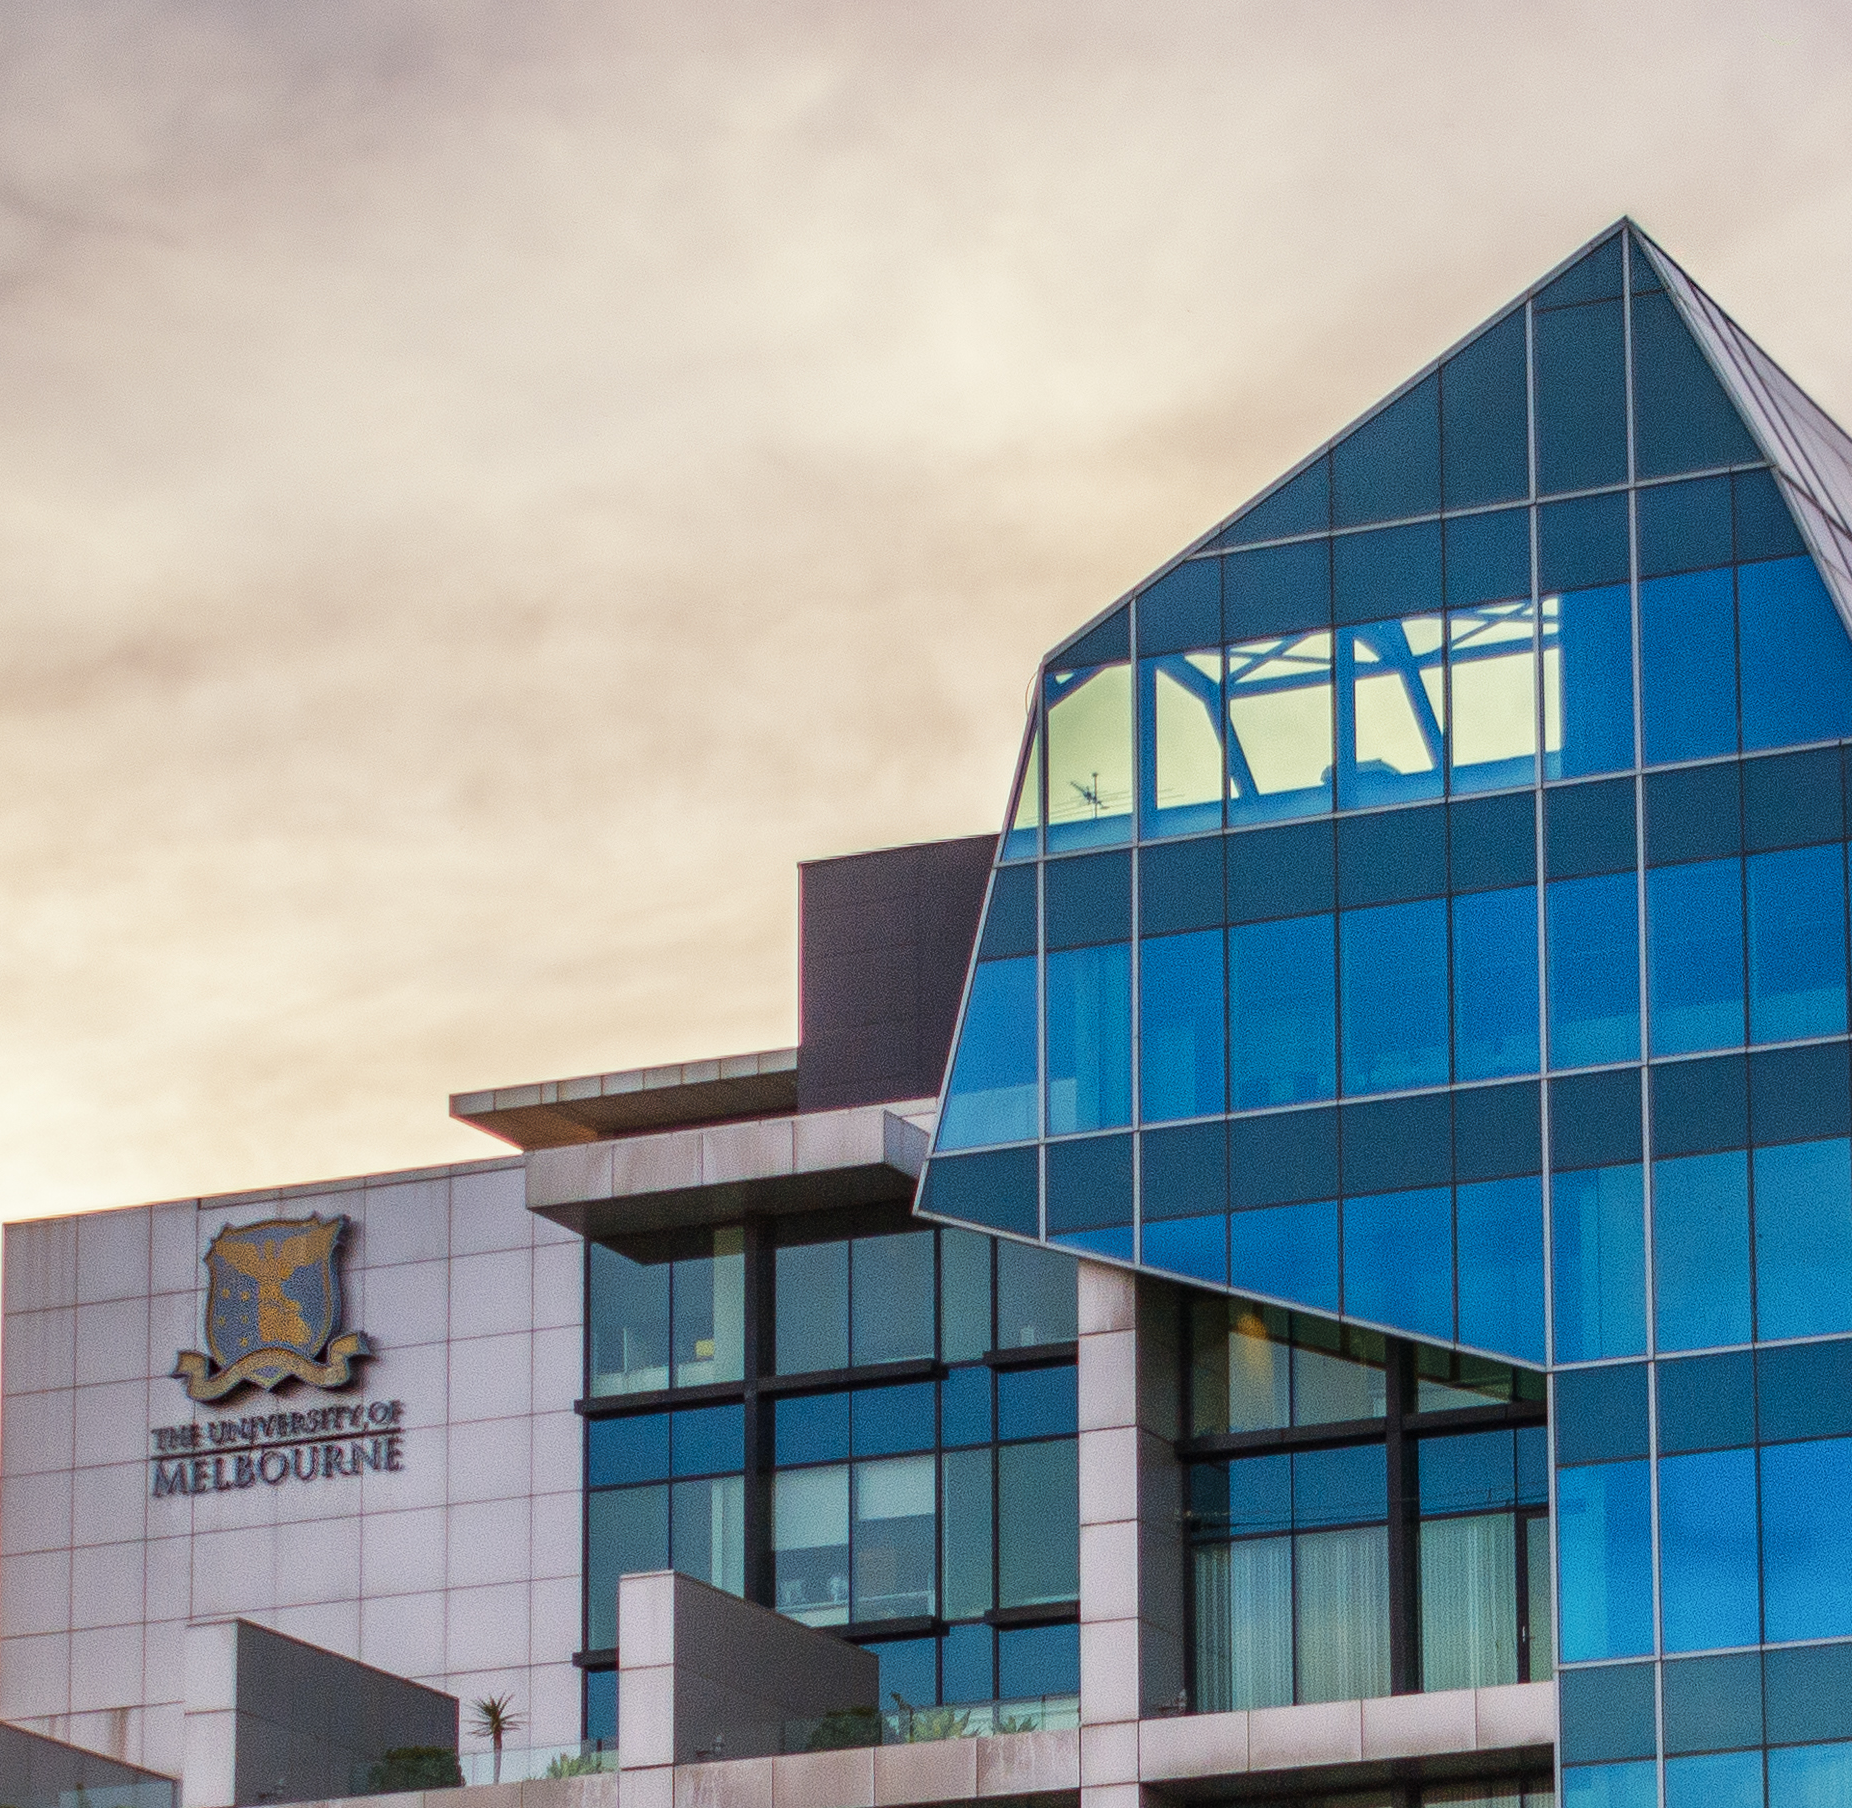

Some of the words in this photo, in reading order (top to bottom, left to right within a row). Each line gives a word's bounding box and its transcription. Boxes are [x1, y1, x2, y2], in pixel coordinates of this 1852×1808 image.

[151, 1423, 201, 1451] THE
[210, 1405, 365, 1446] UNIVERSITY
[369, 1400, 404, 1426] OF
[151, 1437, 404, 1497] MELBOURNE
